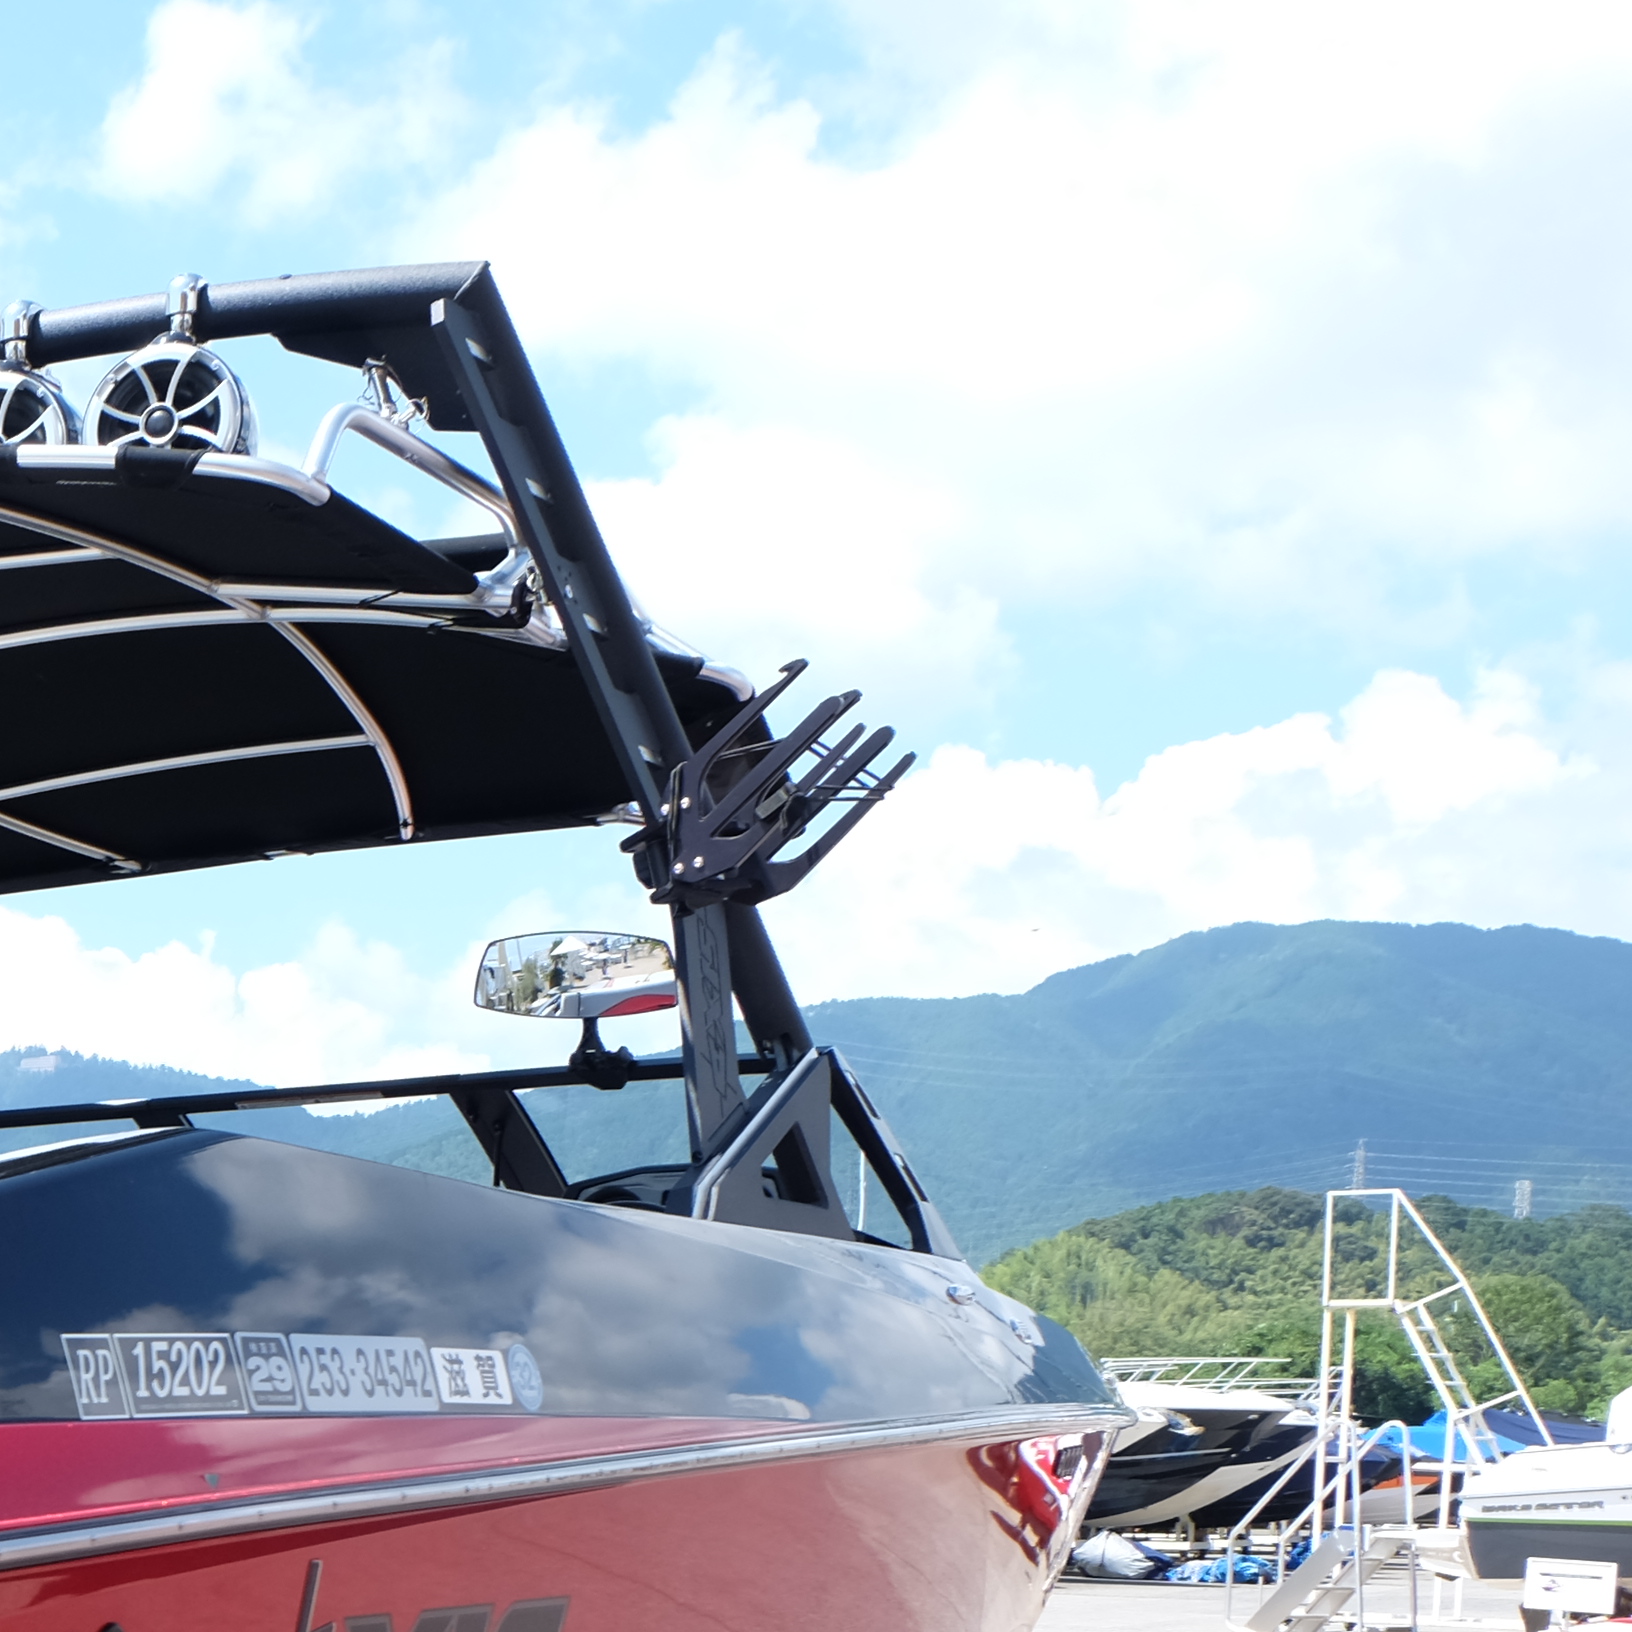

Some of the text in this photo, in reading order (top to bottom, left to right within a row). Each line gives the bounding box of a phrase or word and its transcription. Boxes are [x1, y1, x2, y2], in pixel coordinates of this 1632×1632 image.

[76, 1340, 228, 1404] RP 15202
[246, 1356, 293, 1392] 29
